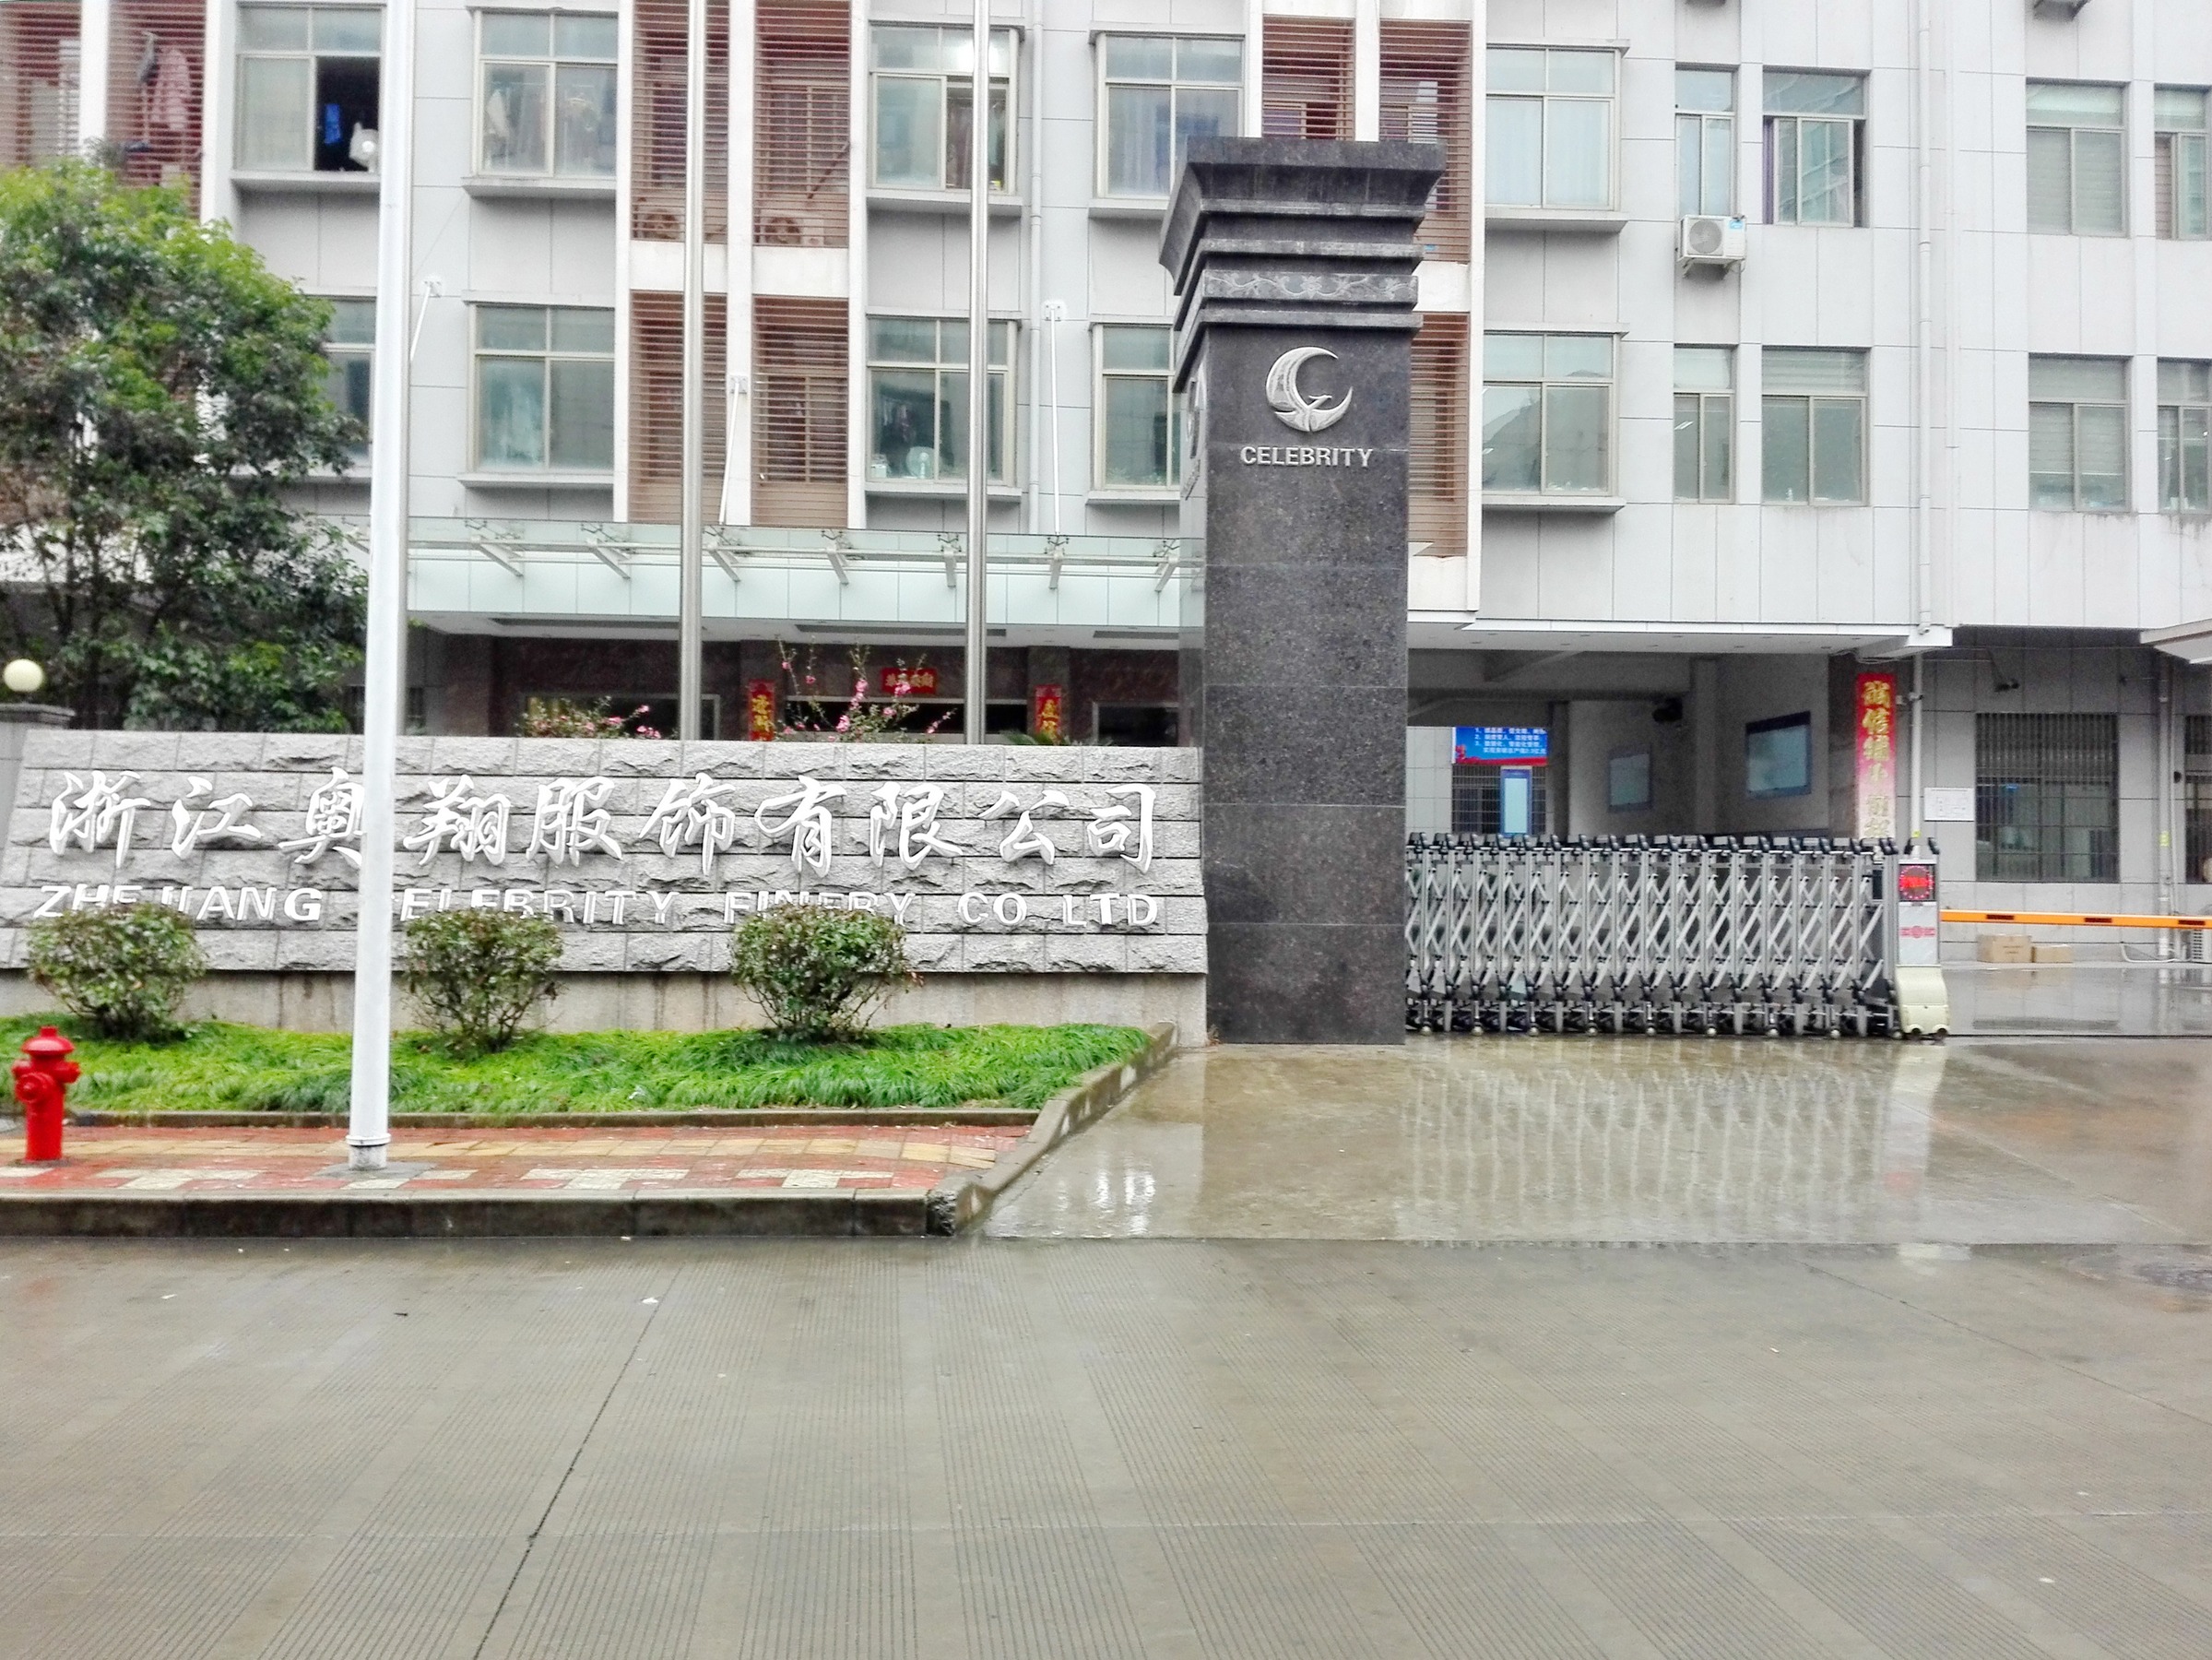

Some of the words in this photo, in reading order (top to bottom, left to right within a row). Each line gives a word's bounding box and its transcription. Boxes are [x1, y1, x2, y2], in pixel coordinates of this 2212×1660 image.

[1240, 445, 1373, 468] CELEBRITY
[49, 766, 1156, 877] 浙江奥翔服饰有限公司
[391, 887, 680, 925] ELEBRITY
[956, 892, 1027, 926] CO
[1062, 894, 1157, 926] LTD
